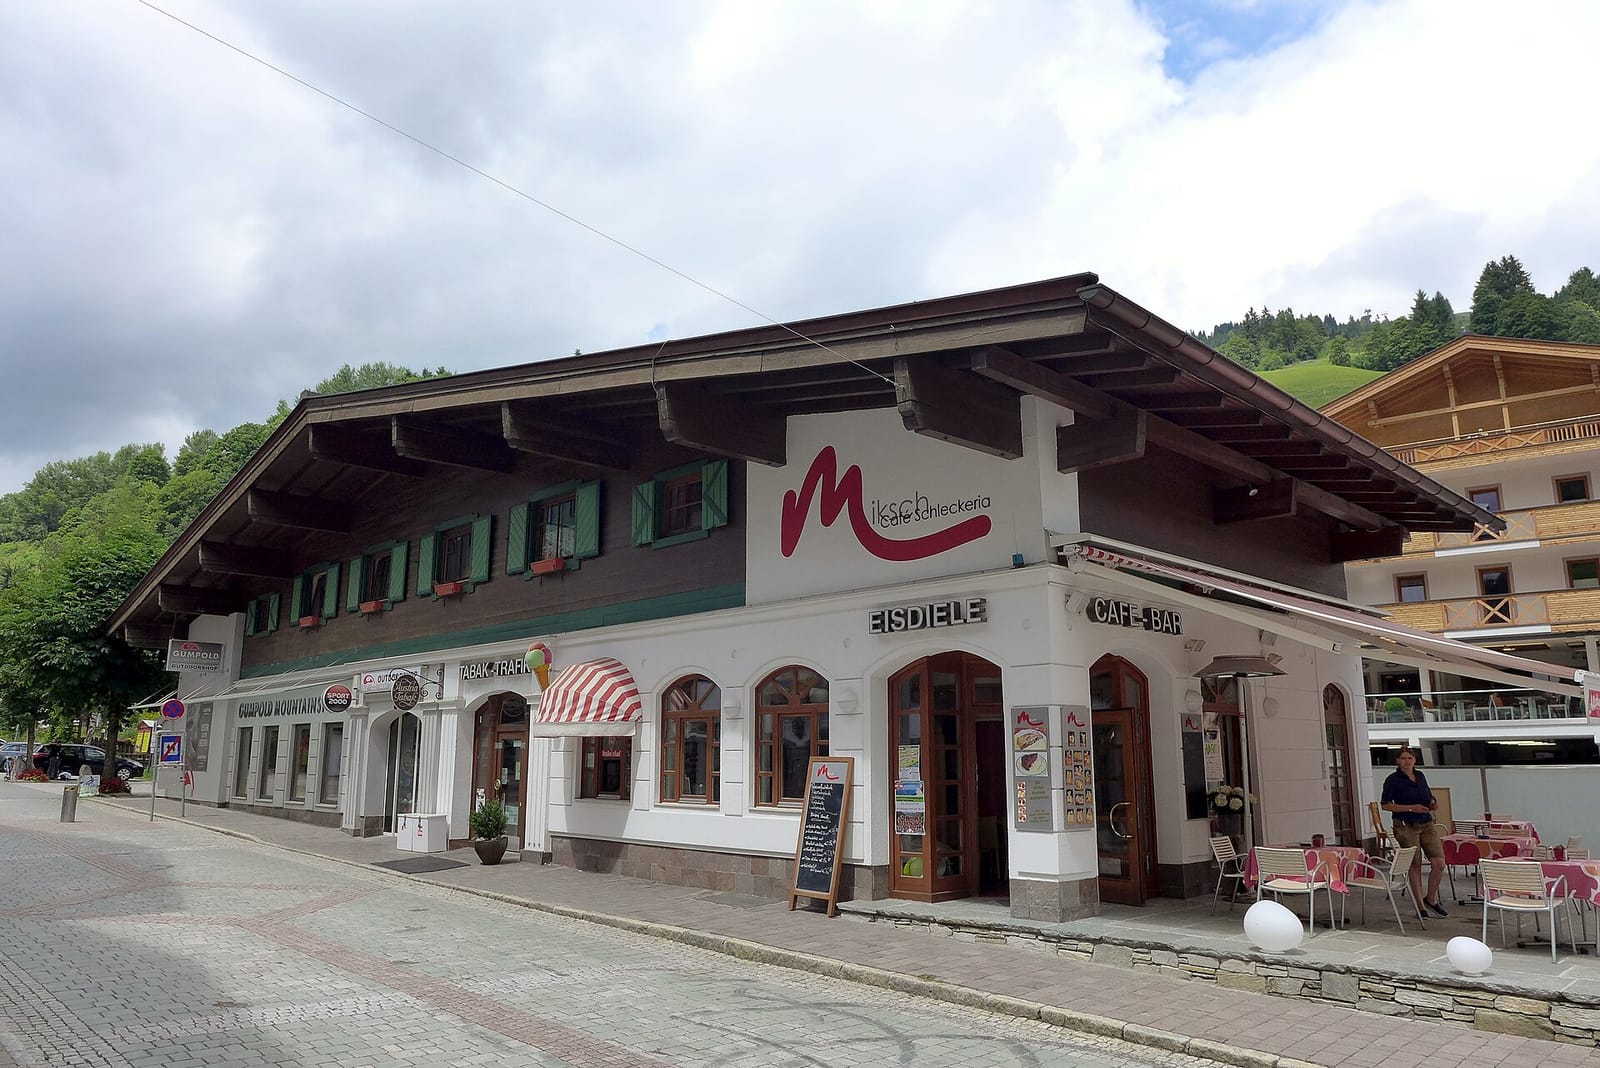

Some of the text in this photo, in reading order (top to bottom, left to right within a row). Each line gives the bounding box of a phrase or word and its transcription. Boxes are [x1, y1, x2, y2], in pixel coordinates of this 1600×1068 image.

[880, 495, 991, 528] Café Schleckeria
[868, 598, 987, 634] EISDIELE
[173, 650, 219, 659] GUMPOLD
[239, 701, 273, 718] GUMPOLD
[274, 696, 325, 716] MOUNTAINS
